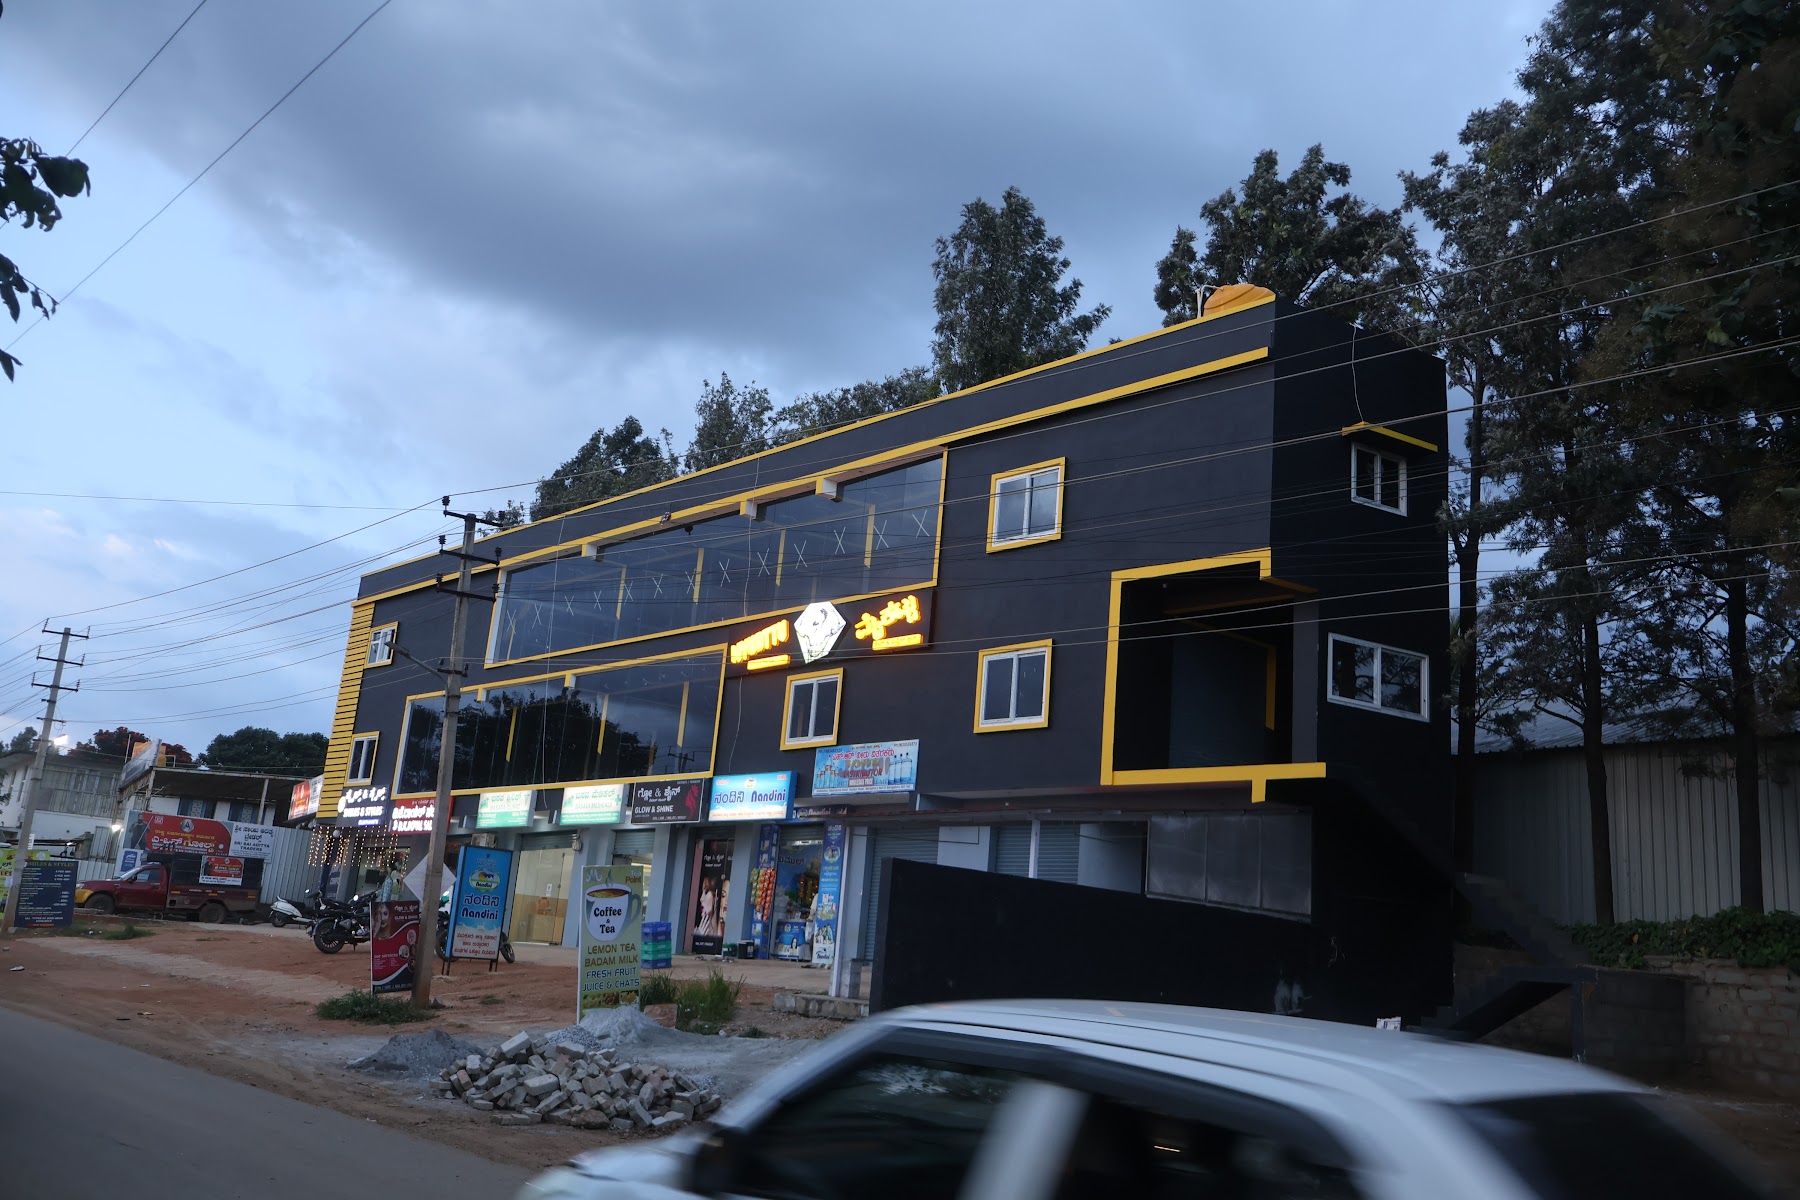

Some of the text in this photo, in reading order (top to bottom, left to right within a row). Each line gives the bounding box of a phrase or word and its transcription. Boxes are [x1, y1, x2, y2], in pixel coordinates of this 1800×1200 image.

[714, 791, 745, 804] ನಂದಿನಿ
[751, 789, 786, 802] Nandini
[656, 805, 674, 813] SHINE
[463, 894, 499, 907] ನಂದಿನಿ
[462, 908, 498, 920] Nandini
[594, 907, 622, 917] Coffee
[600, 924, 615, 934] Tea
[588, 943, 636, 954] LEMON TEA
[585, 954, 638, 967] BADAM MILK
[586, 967, 636, 979] FRESH FRUIT
[583, 979, 639, 992] JUICE & CHATS
